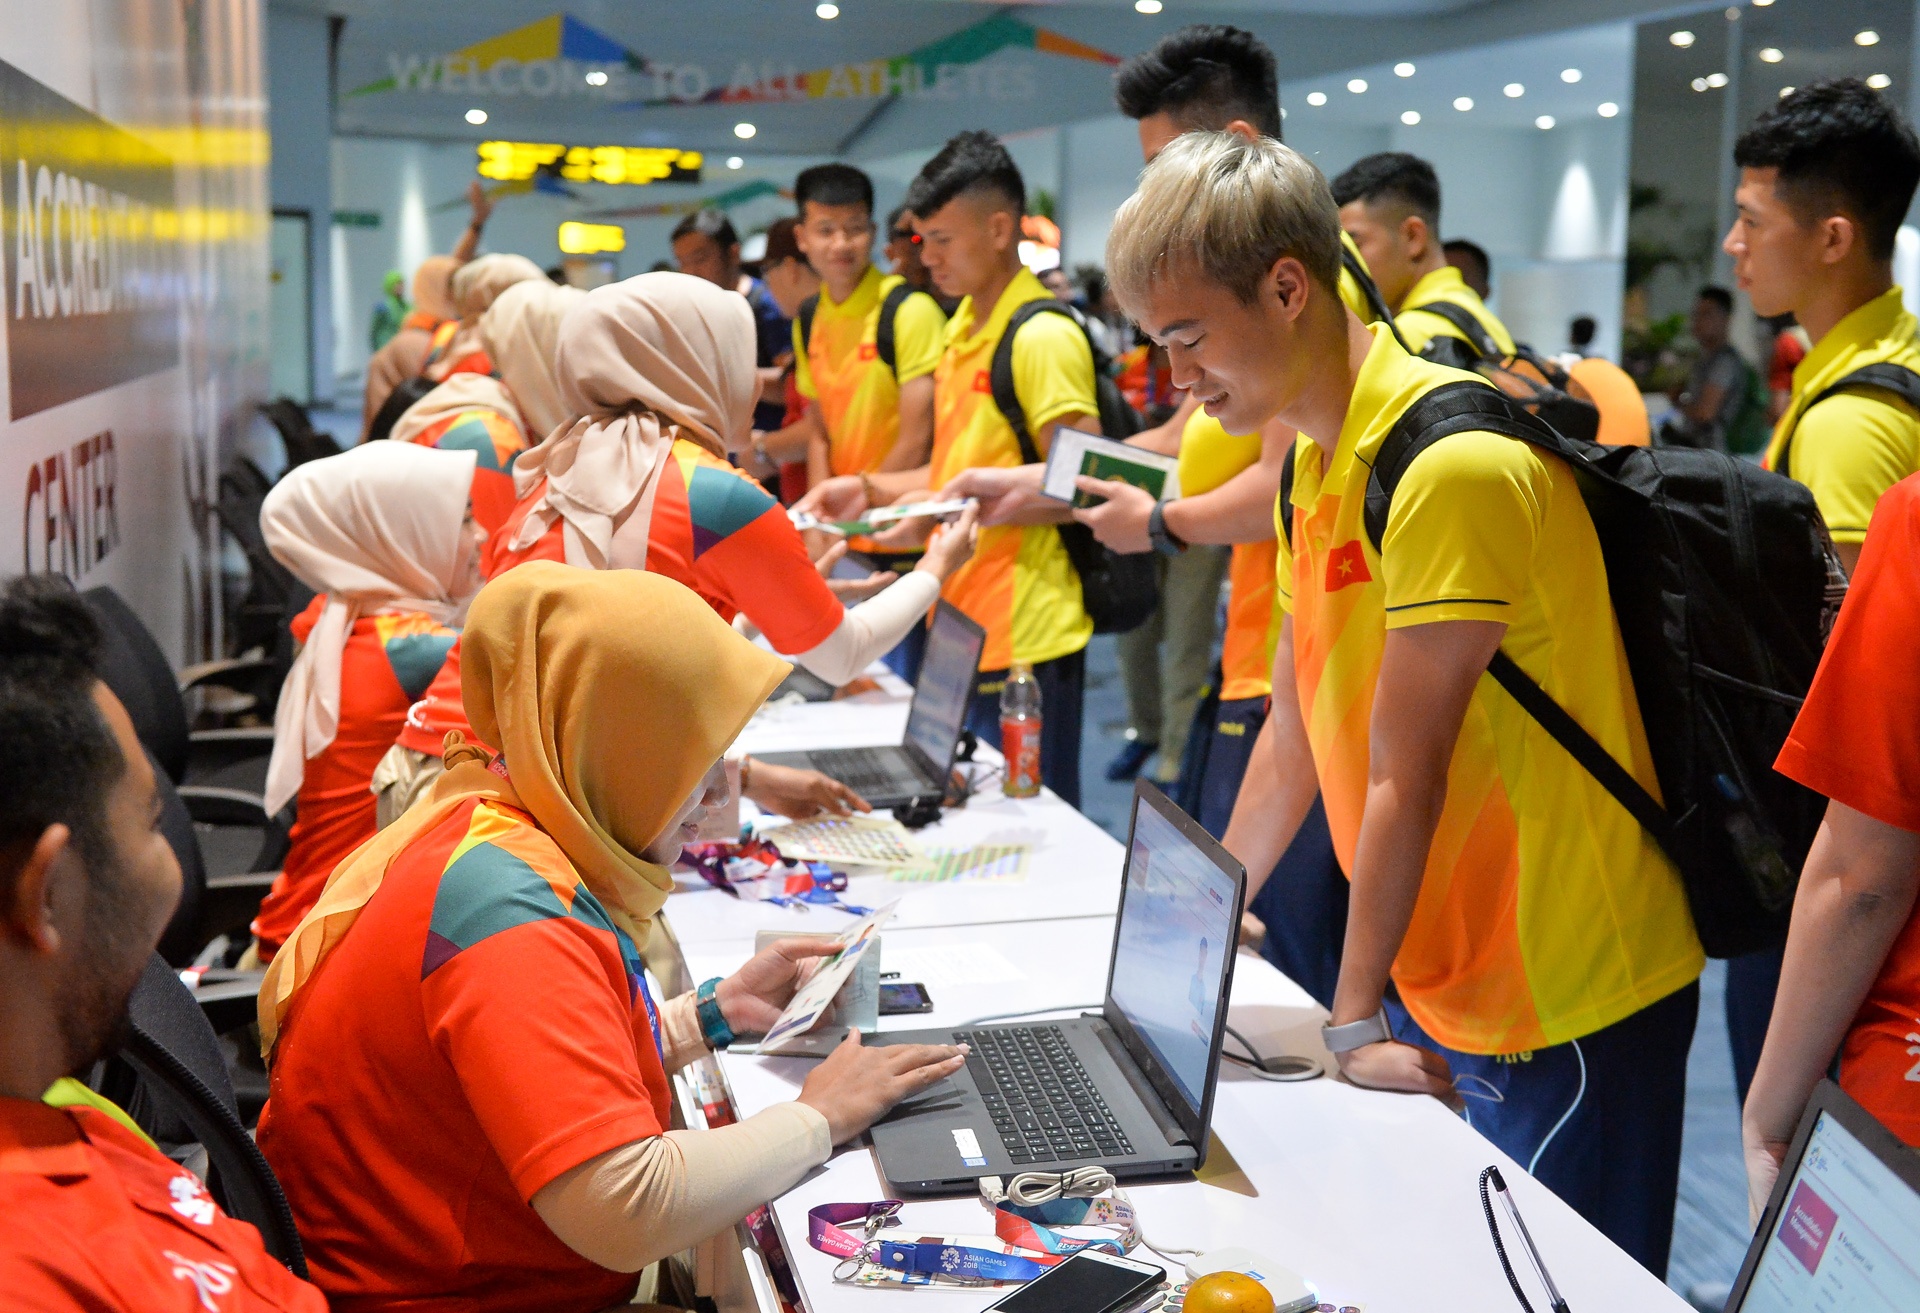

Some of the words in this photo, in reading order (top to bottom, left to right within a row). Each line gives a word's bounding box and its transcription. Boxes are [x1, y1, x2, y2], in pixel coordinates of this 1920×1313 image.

[388, 52, 628, 98] WELCOME
[649, 62, 709, 101] TO
[729, 61, 809, 100] ALL
[827, 58, 1036, 99] ATHLETES
[816, 1234, 836, 1246] GAMES
[963, 1254, 984, 1262] ASIAN
[984, 1257, 1007, 1267] GAMES
[963, 1261, 978, 1269] 2018
